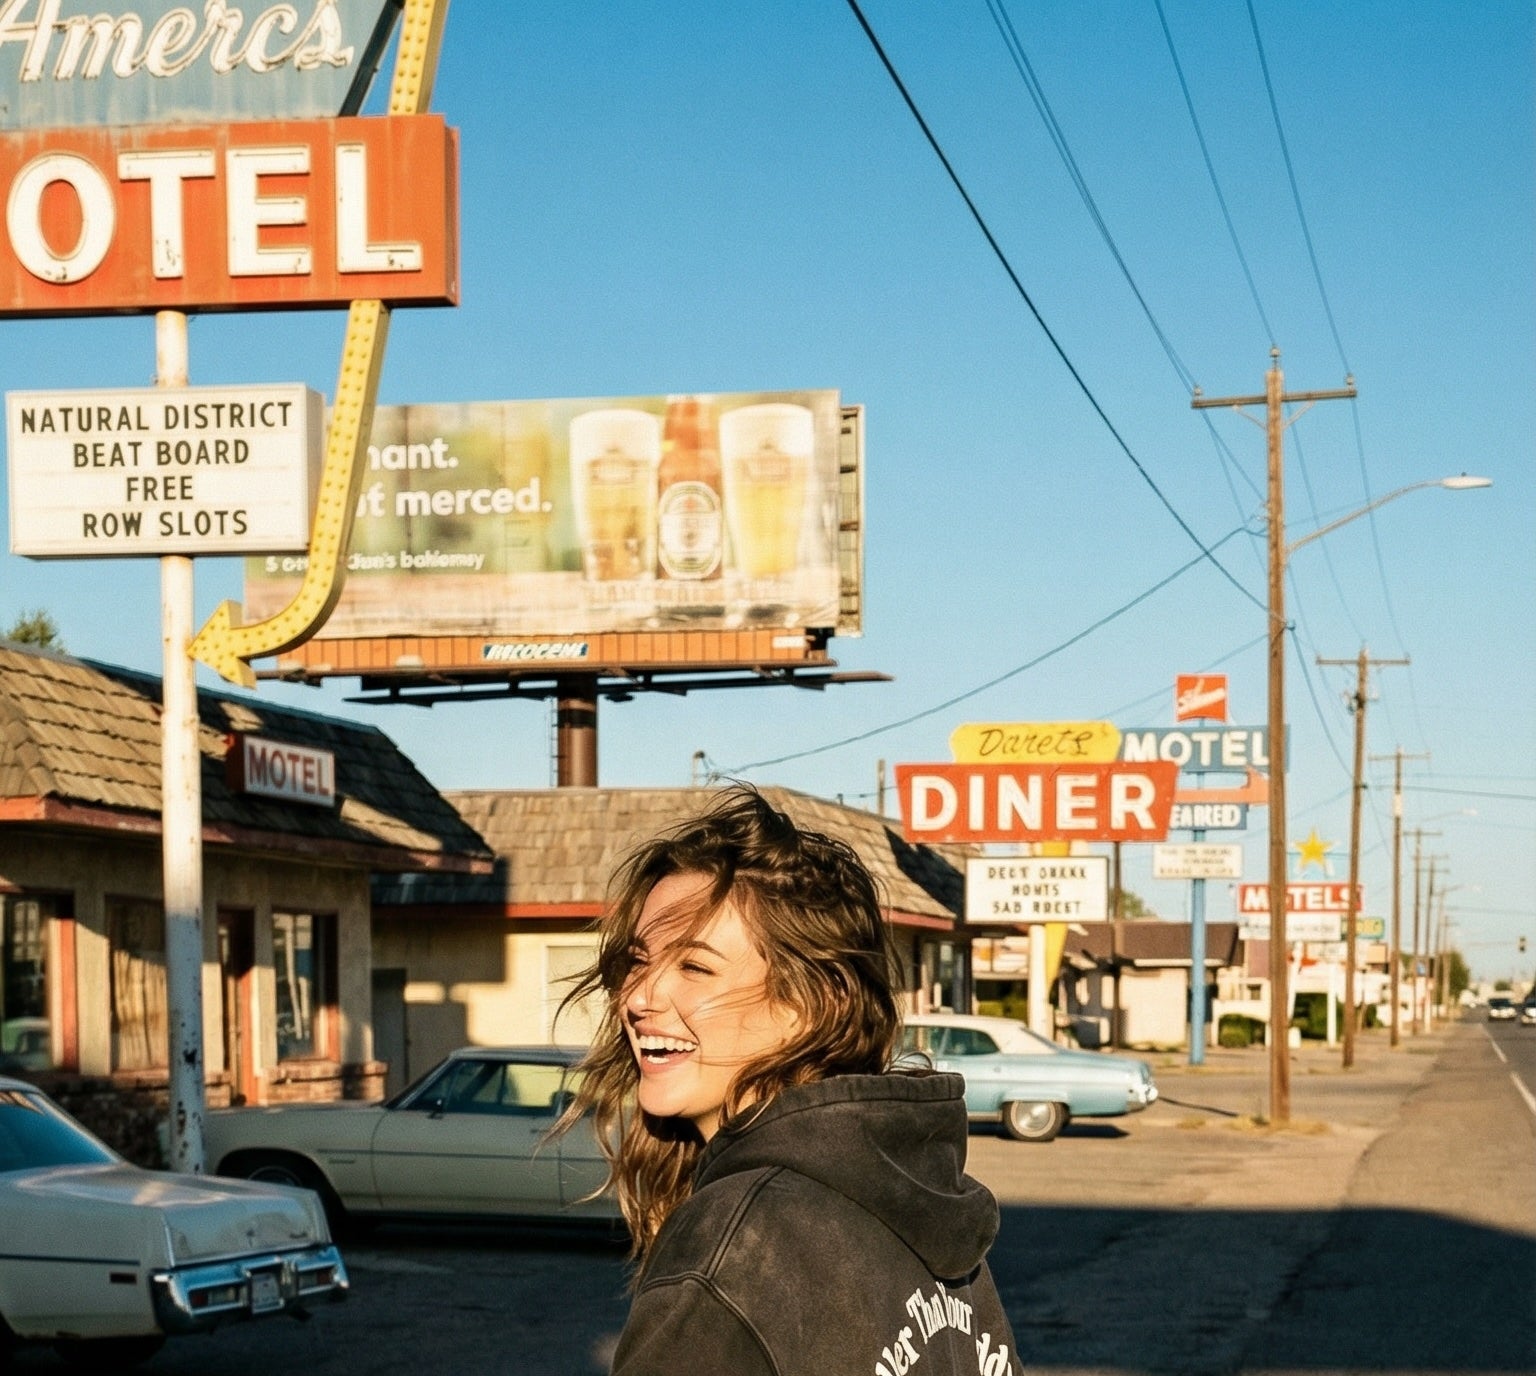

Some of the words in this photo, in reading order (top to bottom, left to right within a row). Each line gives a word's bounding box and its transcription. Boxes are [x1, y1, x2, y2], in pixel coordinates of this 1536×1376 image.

[21, 405, 149, 433] NATURAL
[165, 402, 292, 430] DISTRICT
[73, 442, 142, 467] BEAT
[157, 440, 249, 465] BOARD
[127, 476, 193, 501] FREE
[396, 477, 553, 516] merced.
[83, 513, 141, 537] ROW
[159, 510, 247, 536] SLOTS
[1124, 731, 1268, 766] MOTEL
[249, 744, 329, 796] MOTEL
[910, 773, 1156, 831] DINER
[1243, 886, 1350, 910] MTELS
